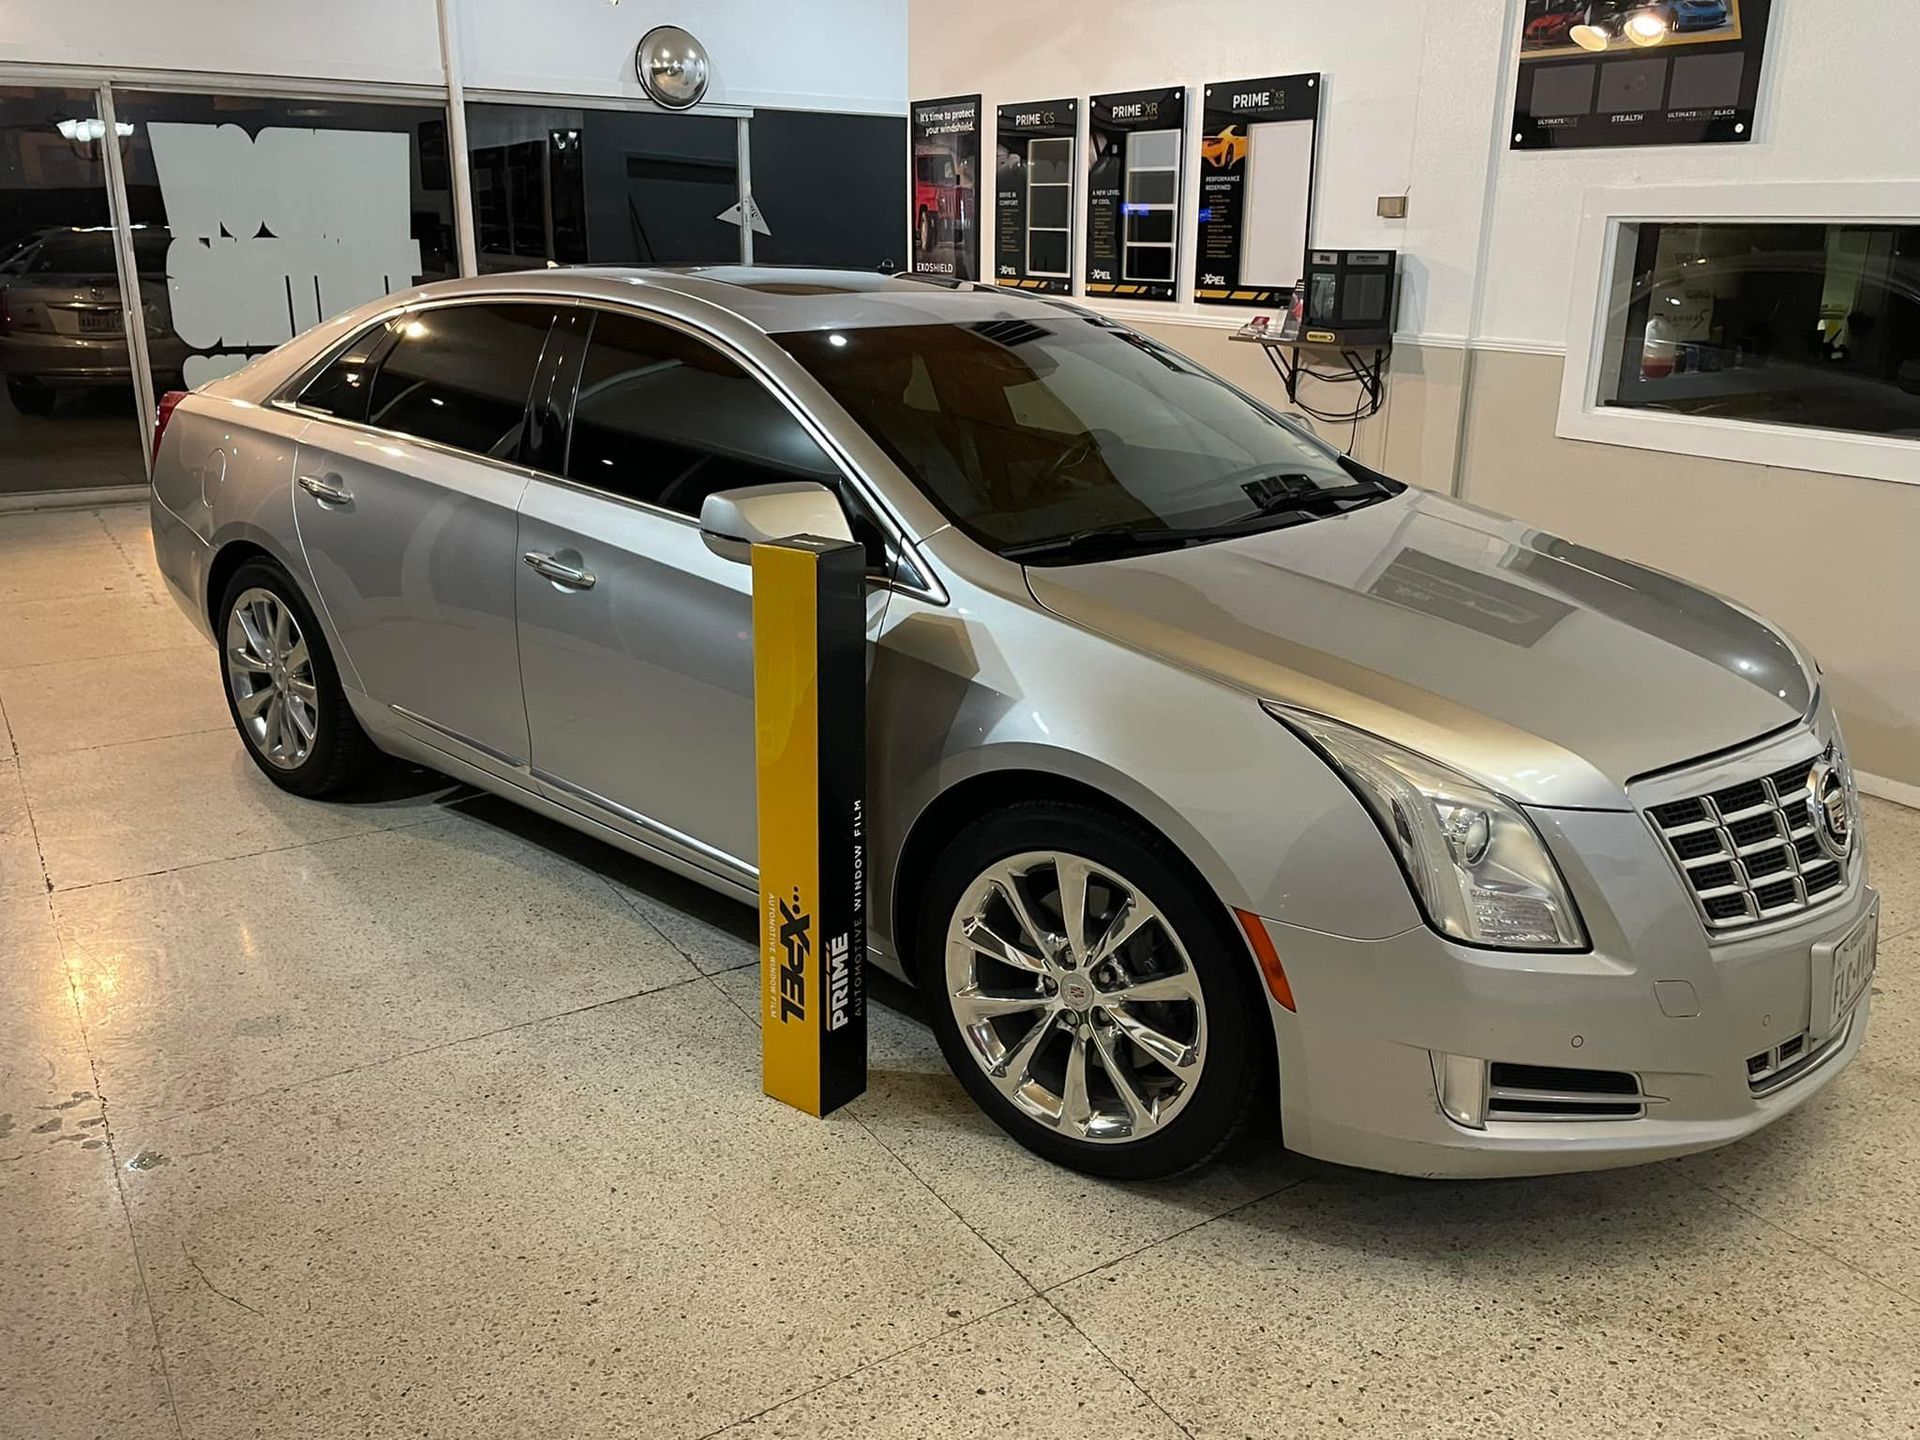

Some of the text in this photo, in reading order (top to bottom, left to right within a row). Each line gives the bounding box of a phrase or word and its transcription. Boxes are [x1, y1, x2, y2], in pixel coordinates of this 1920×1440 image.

[1233, 91, 1270, 109] PRIME
[919, 108, 975, 122] It's time to protect
[1112, 104, 1142, 119] PRIME
[1145, 102, 1158, 115] XR
[1611, 114, 1643, 123] STEALTH
[1015, 112, 1055, 126] PRIME CS
[925, 121, 975, 137] your windshield.
[916, 262, 953, 273] EXOSHIELD
[1092, 270, 1111, 280] XPEL
[1203, 274, 1226, 285] XPEL
[853, 799, 863, 1017] AUTOMOTIVE WINDOW FILM
[768, 892, 778, 1018] AUTOMOTIVE WINDOW FILM
[779, 897, 810, 1024] XPEL
[831, 932, 849, 1030] PRIME
